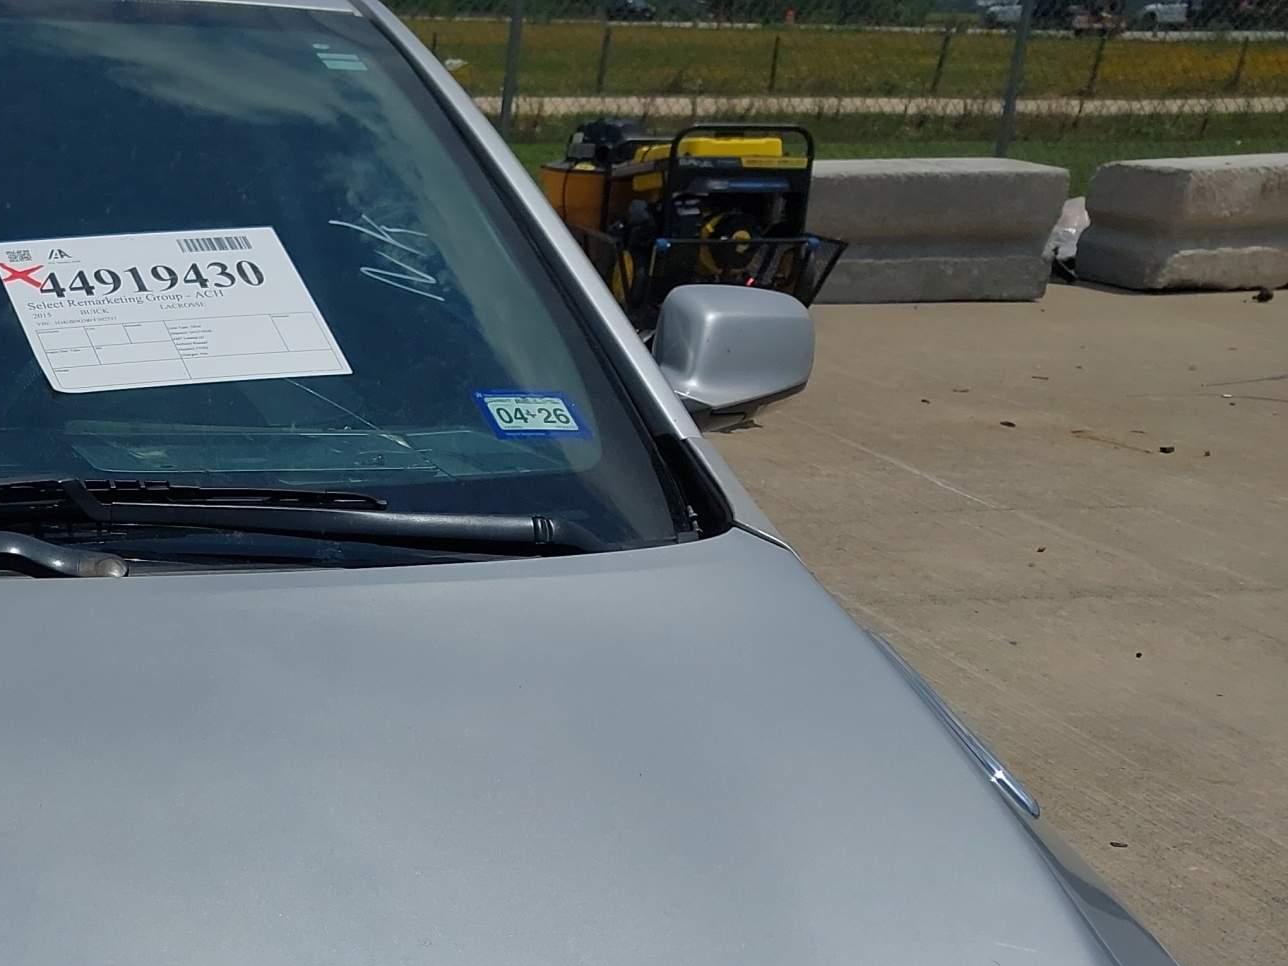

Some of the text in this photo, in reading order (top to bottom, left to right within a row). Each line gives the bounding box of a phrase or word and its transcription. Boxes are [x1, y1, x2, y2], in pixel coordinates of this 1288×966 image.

[40, 260, 265, 298] 44919430
[27, 301, 64, 311] Select
[67, 295, 144, 308] Remarketing
[146, 293, 183, 302] Group
[80, 308, 110, 316] BUICK
[159, 302, 206, 310] LACROSSE
[496, 407, 571, 425] 04 26
